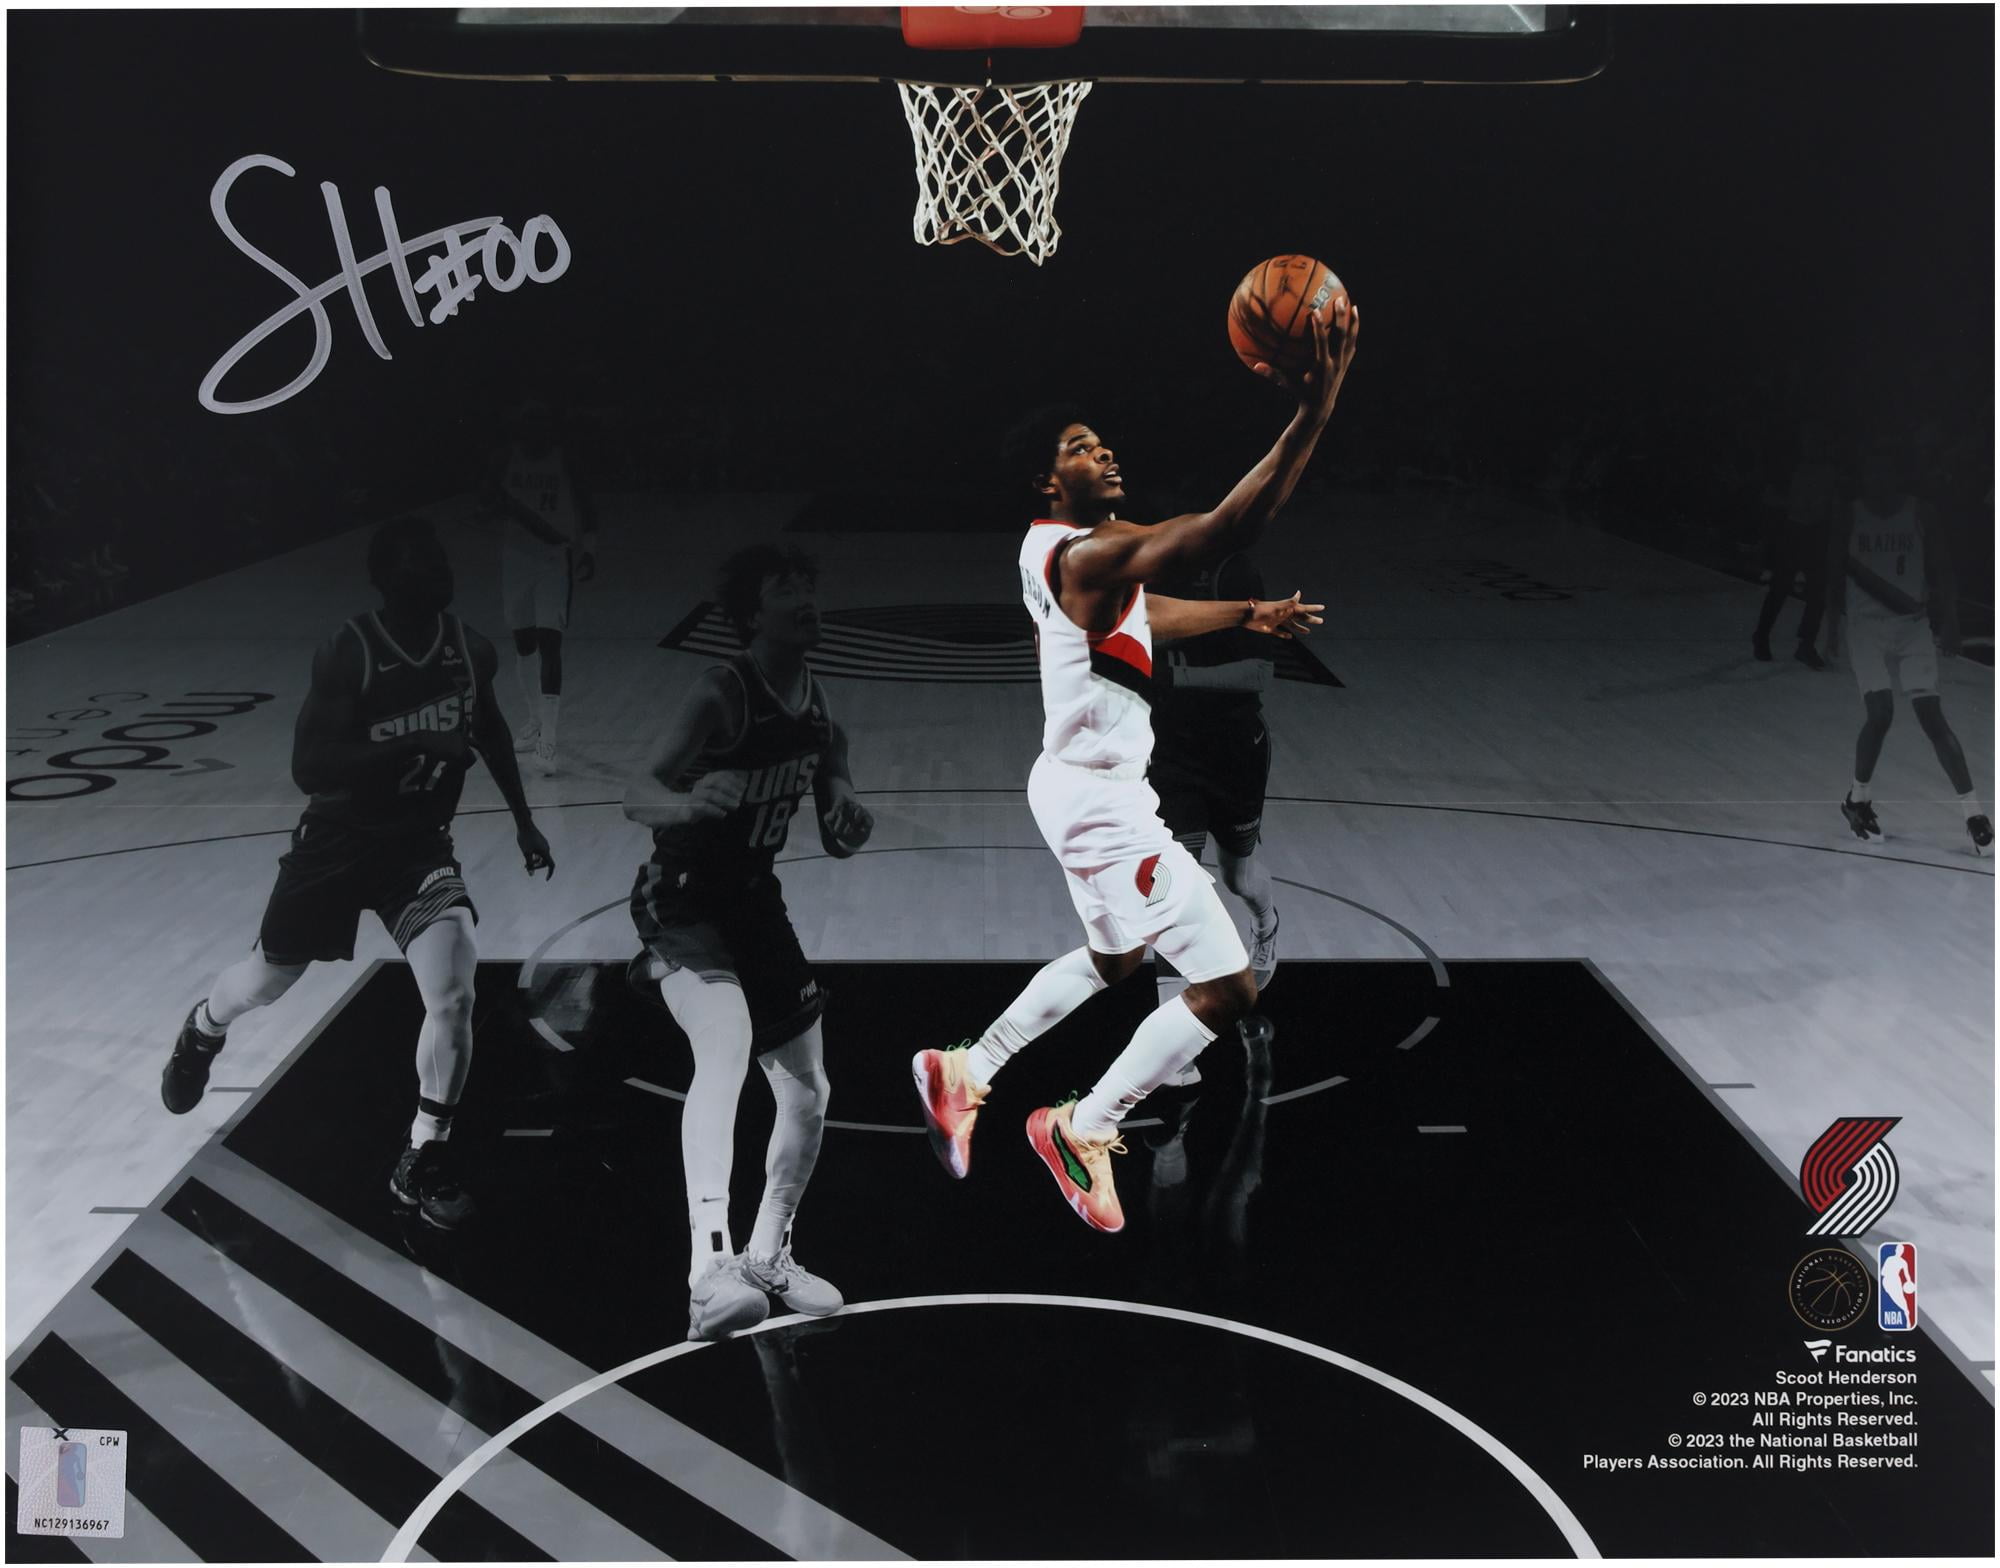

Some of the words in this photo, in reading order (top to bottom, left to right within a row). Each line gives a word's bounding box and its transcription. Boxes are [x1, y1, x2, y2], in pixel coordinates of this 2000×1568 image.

[749, 800, 793, 848] 18
[99, 1436, 120, 1446] CPW
[34, 1518, 110, 1531] NC129136967
